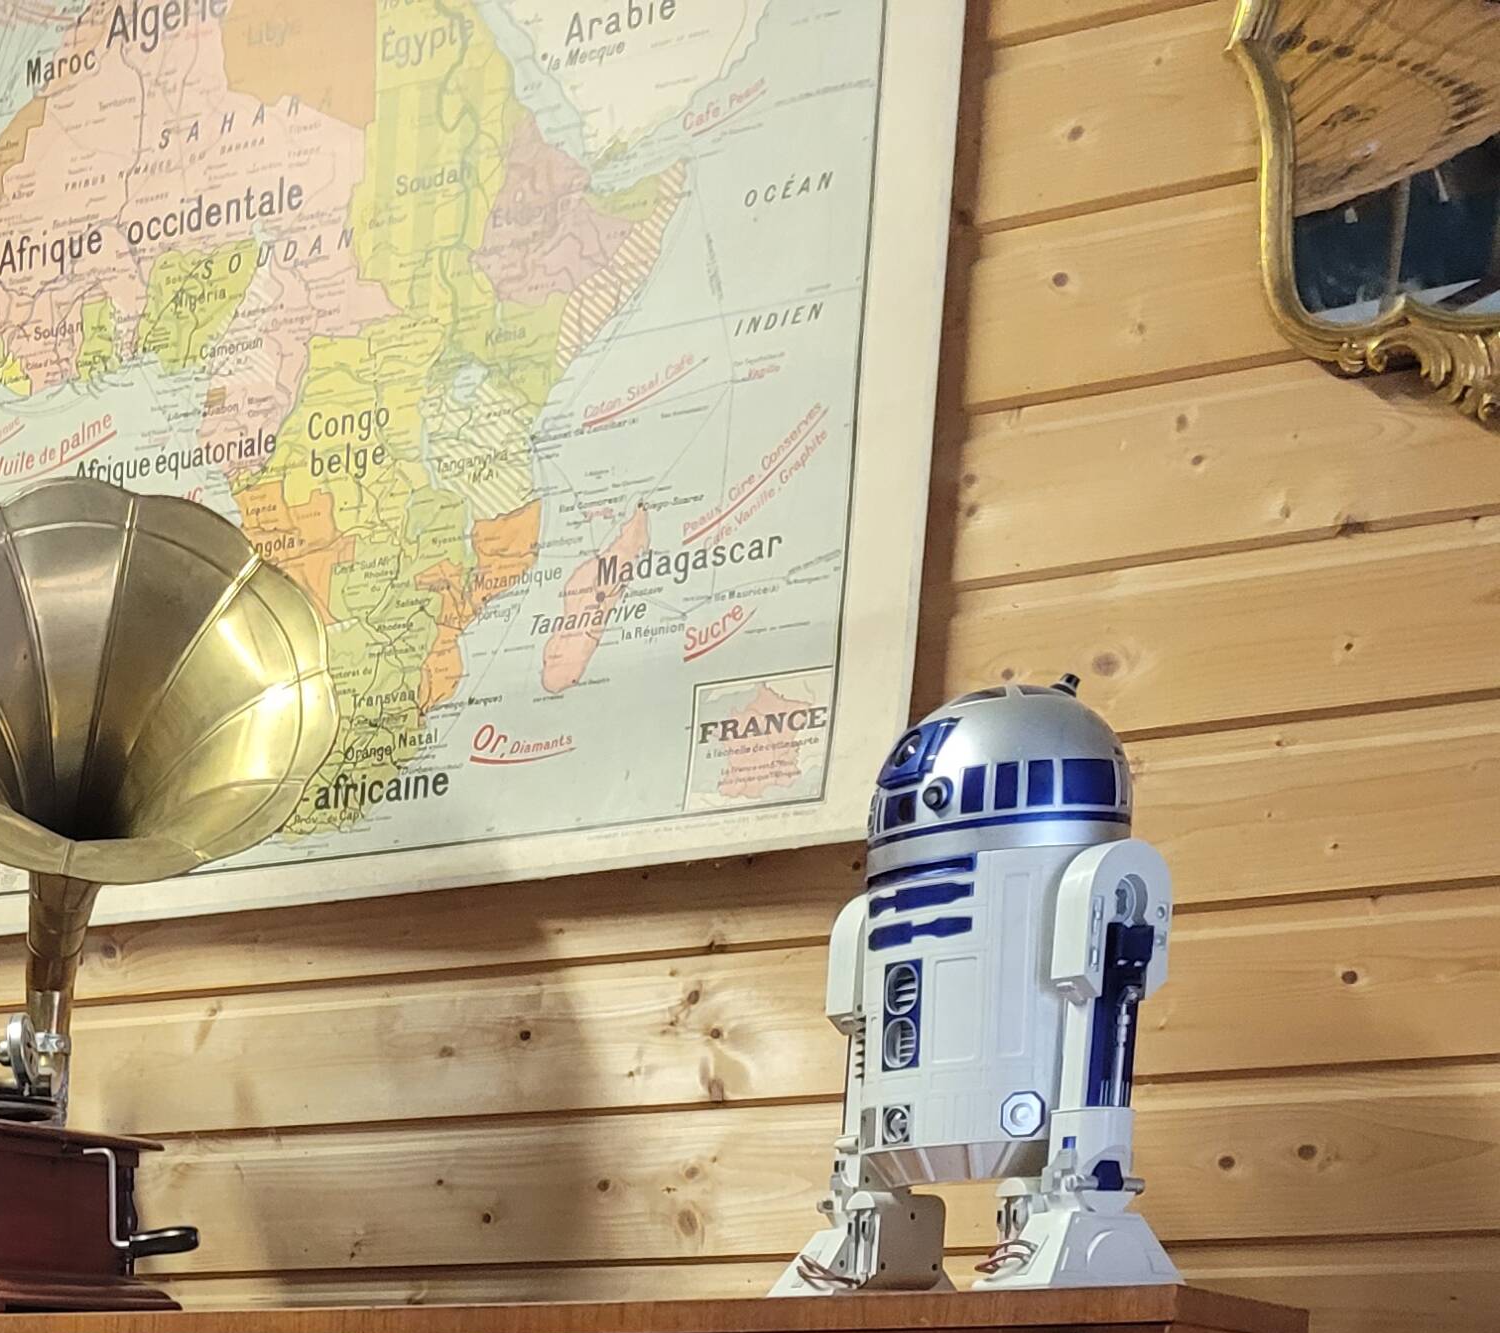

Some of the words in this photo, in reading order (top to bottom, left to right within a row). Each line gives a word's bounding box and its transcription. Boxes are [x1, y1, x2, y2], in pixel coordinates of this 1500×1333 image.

[26, 49, 97, 87] Maroc
[565, 41, 626, 68] Mecque
[743, 171, 834, 208] OCÉAN
[127, 176, 304, 246] occidentale
[734, 302, 825, 337] INDIEN
[39, 445, 57, 465] de
[60, 413, 112, 464] palme
[308, 407, 390, 441] Congo
[76, 456, 151, 489] Afrique
[155, 428, 277, 480] équatoriale
[311, 442, 386, 479] belge
[250, 533, 296, 558] ngola
[597, 535, 783, 588] Madagascar
[530, 602, 648, 636] Tananarive
[634, 623, 685, 639] Réunion
[684, 604, 744, 651] Sucre
[399, 728, 438, 749] Natal
[473, 723, 508, 758] Or,
[509, 734, 573, 755] Diamants
[698, 706, 828, 745] FRANCE
